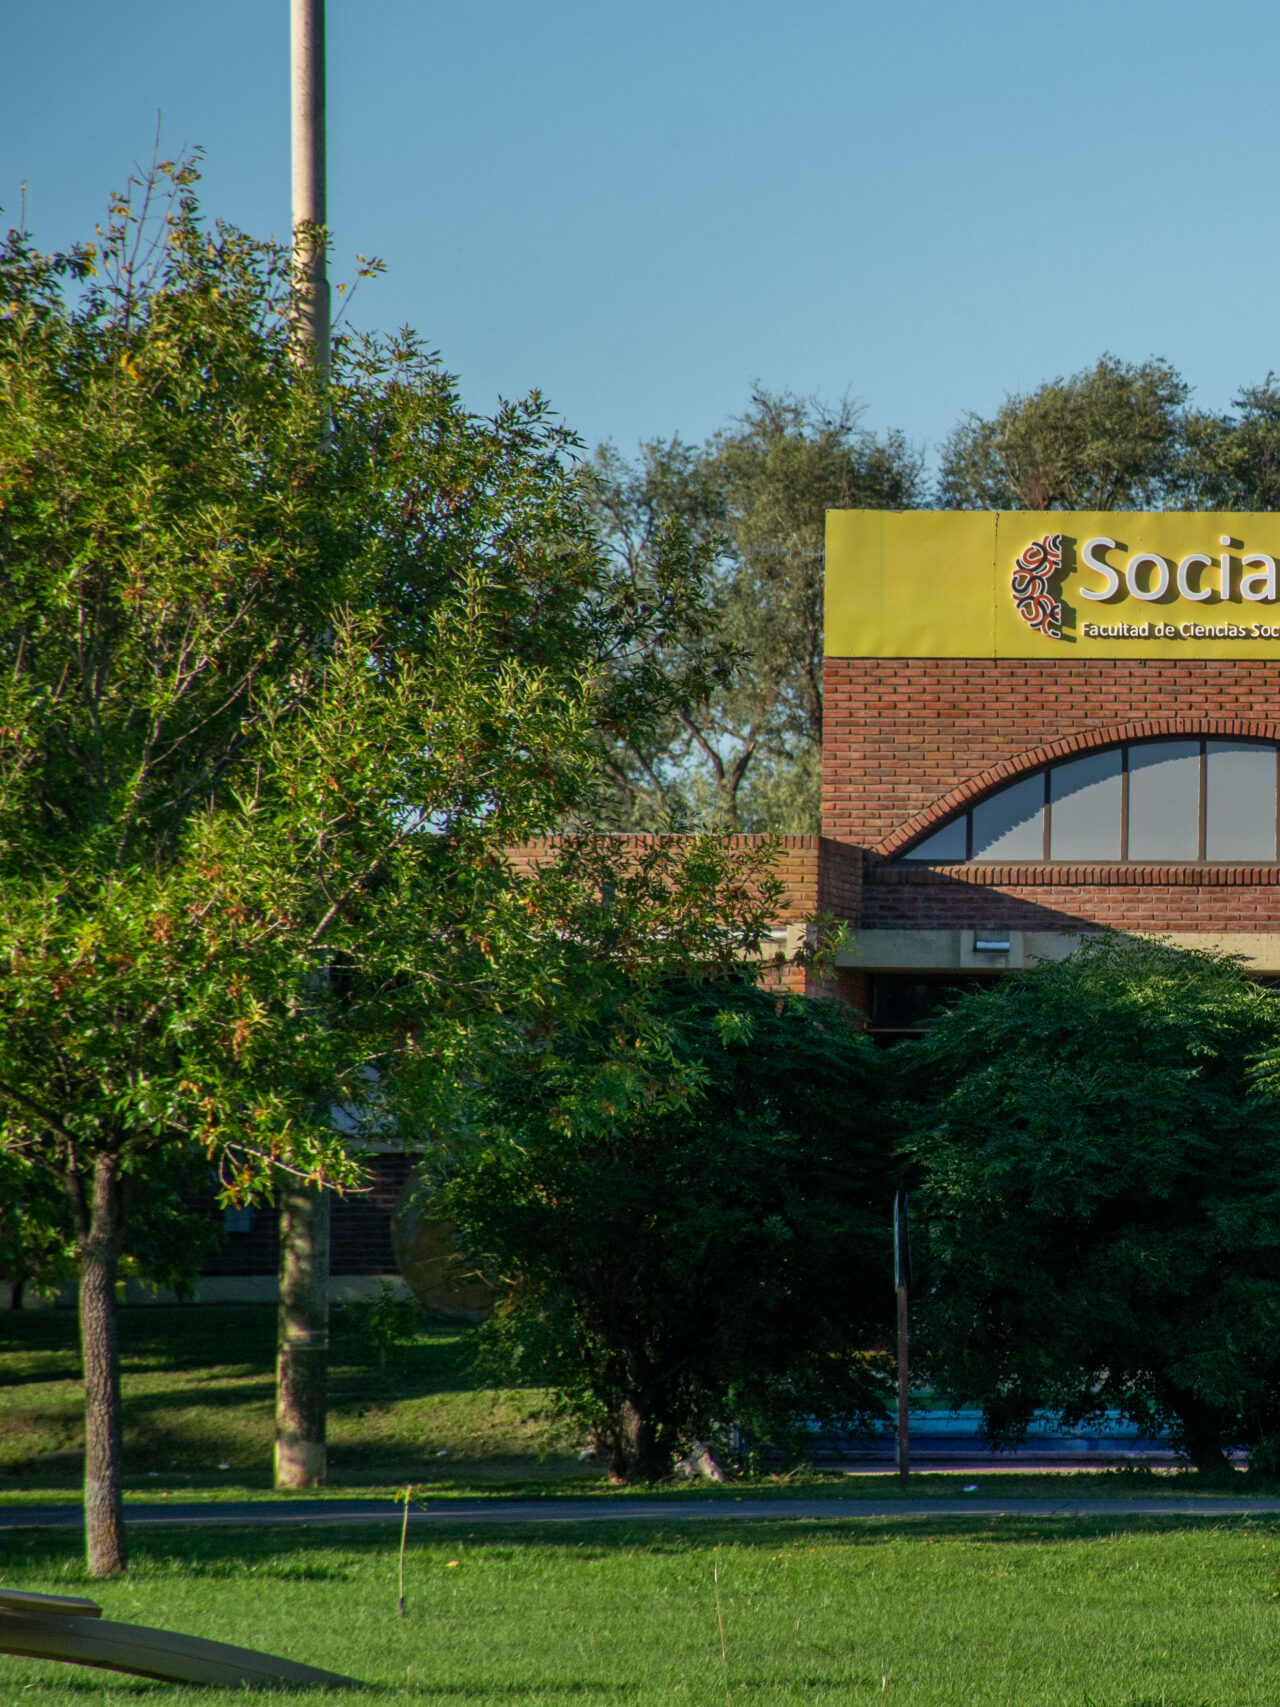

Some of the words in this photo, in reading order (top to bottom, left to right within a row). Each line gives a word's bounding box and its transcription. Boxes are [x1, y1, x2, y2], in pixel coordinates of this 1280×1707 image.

[1081, 621, 1149, 637] Facultad
[1154, 621, 1175, 637] de
[1179, 621, 1246, 637] Ciencias
